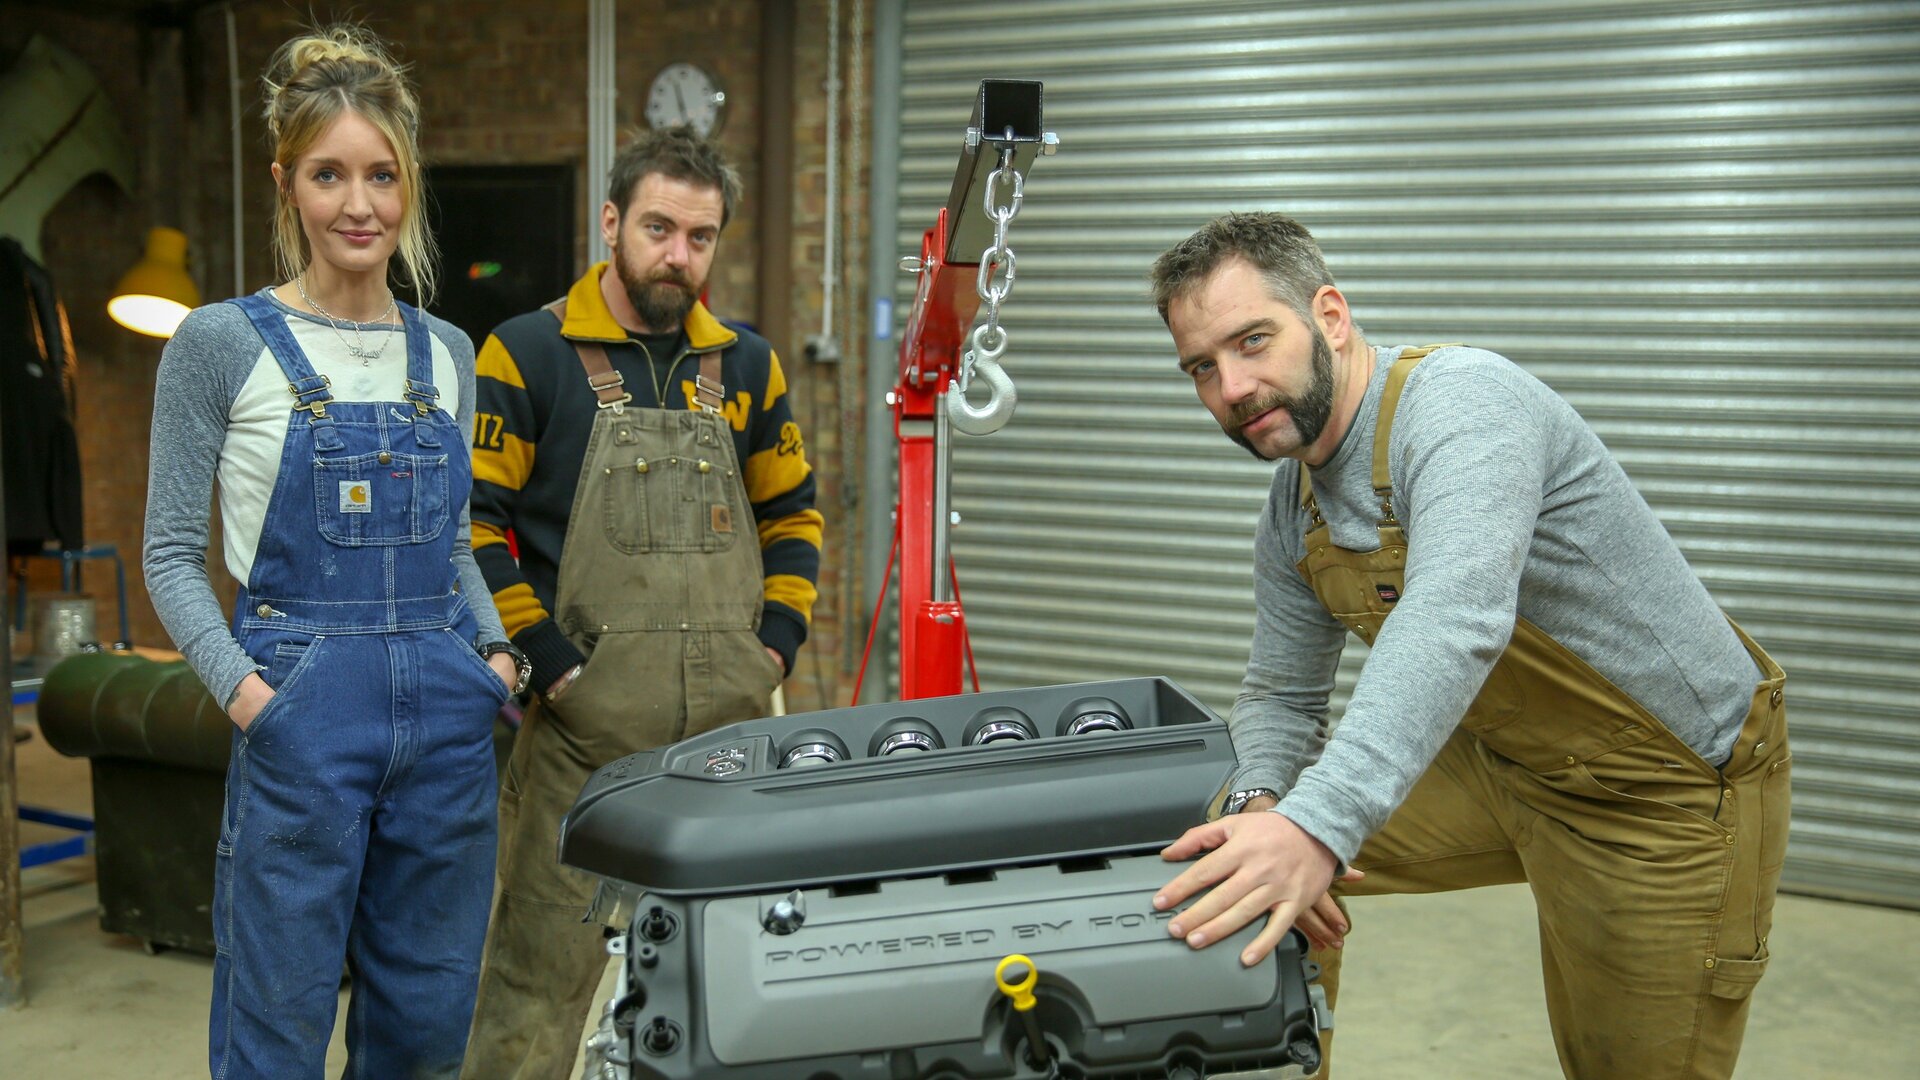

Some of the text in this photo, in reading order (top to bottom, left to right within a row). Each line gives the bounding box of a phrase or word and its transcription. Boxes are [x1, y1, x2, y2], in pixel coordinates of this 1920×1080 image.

[765, 907, 1188, 966] POWERED BY FOR
